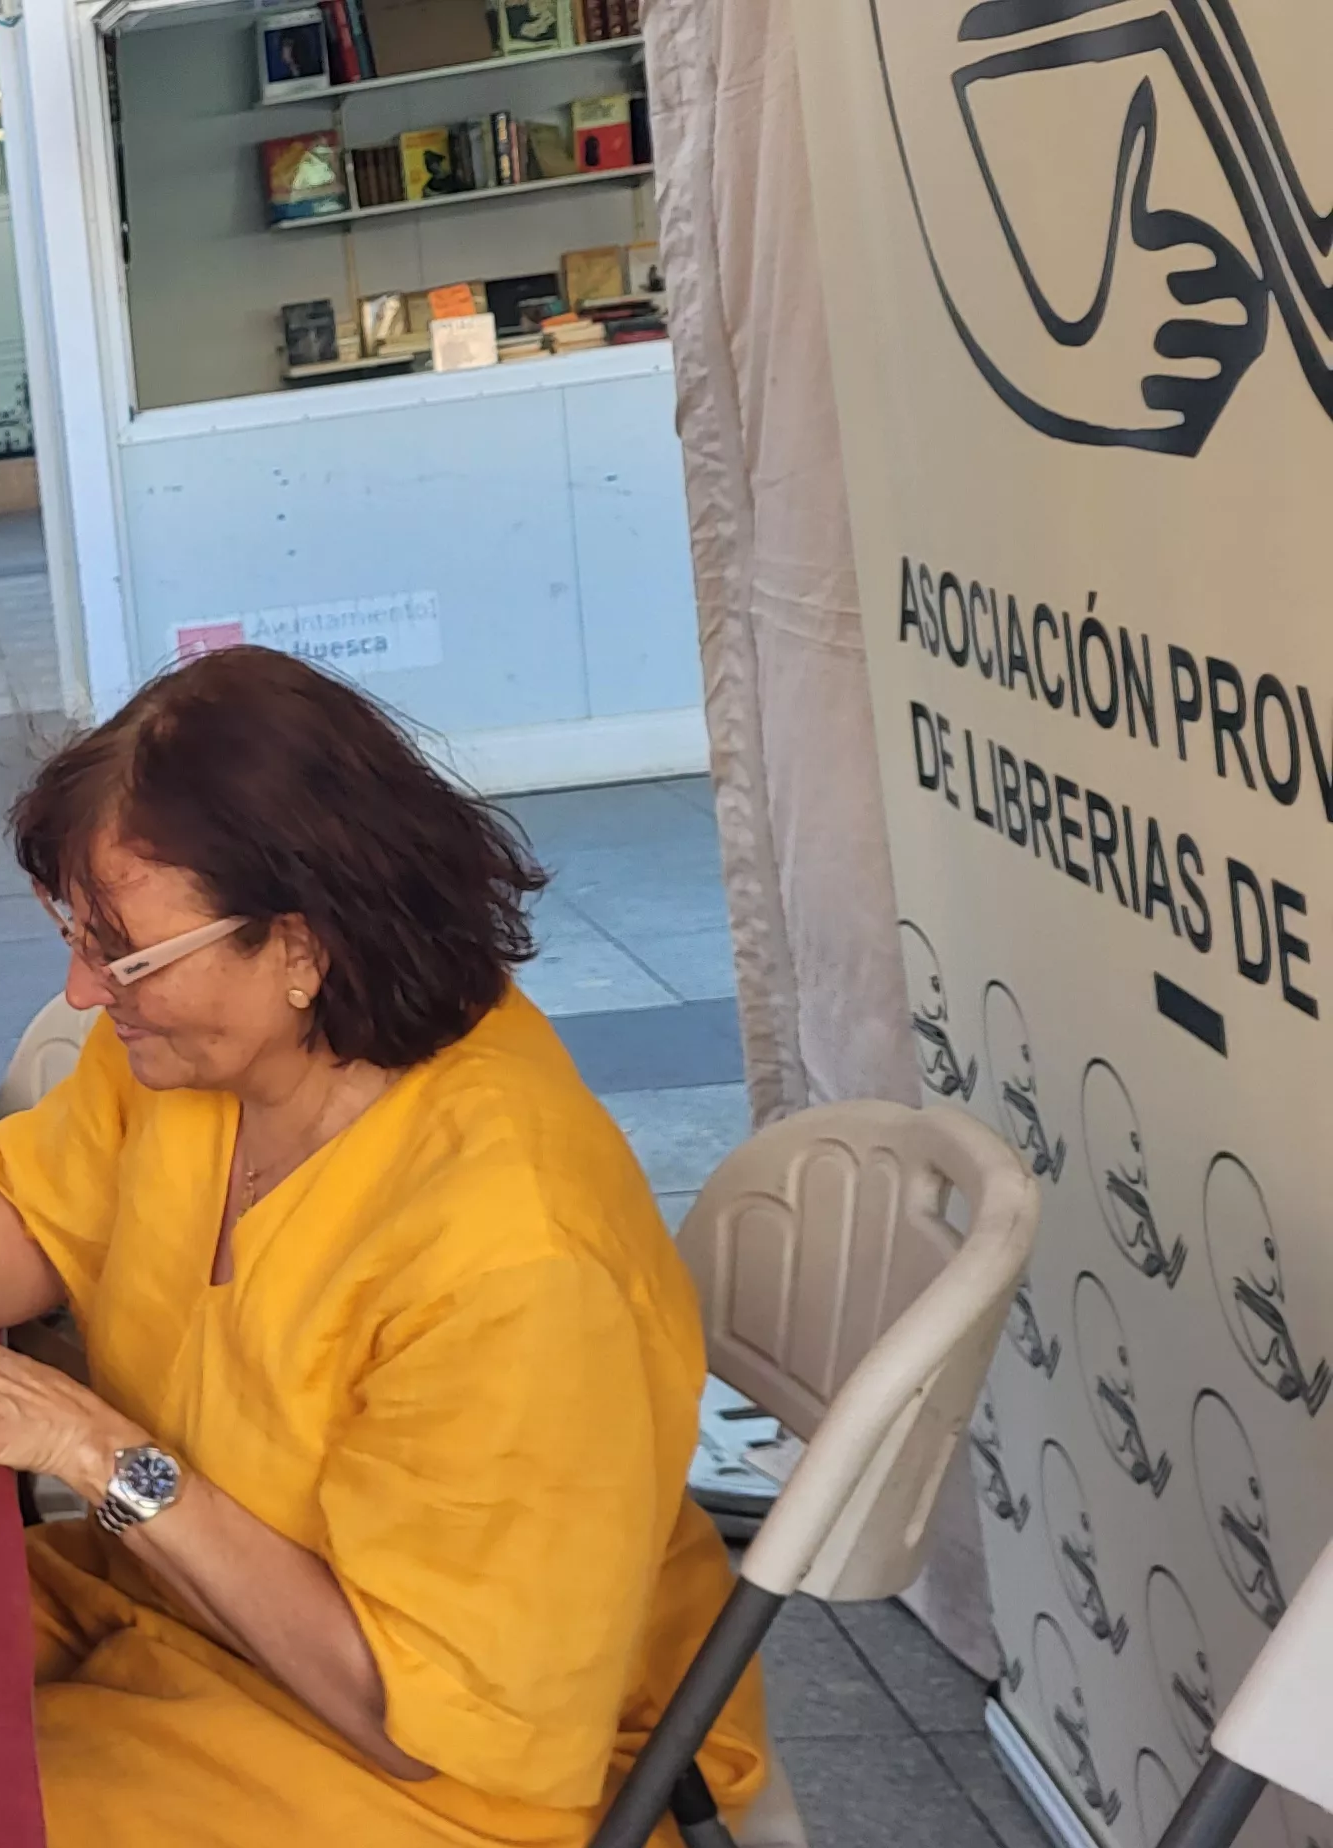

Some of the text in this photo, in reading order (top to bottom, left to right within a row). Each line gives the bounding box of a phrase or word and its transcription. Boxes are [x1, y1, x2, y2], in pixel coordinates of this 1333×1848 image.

[899, 555, 1159, 749] ASOCIACIÓN
[910, 700, 1320, 1021] DE LIBRERIAS DE
